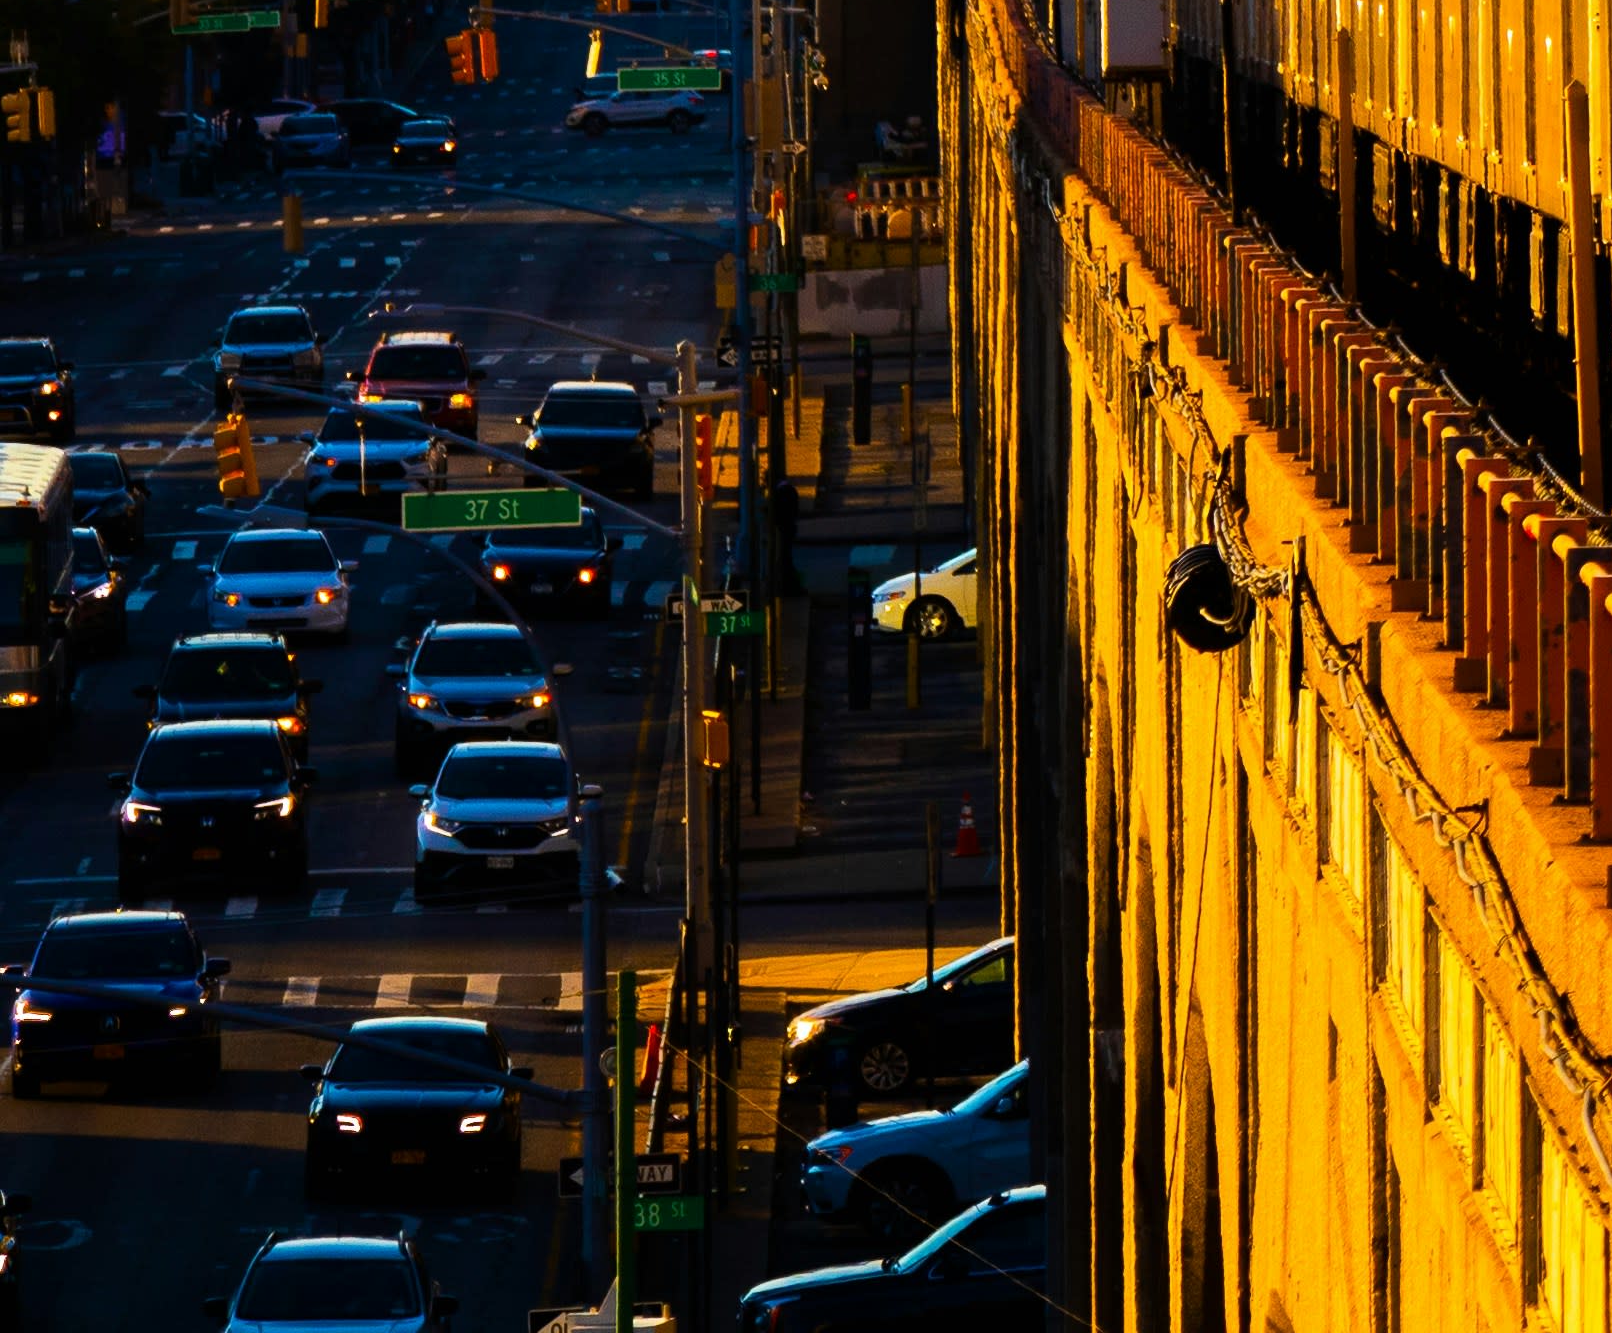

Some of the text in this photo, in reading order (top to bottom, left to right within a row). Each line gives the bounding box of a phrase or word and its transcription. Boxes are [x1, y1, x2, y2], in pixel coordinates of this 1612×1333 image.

[653, 71, 687, 86] 35 St
[464, 498, 521, 522] 37 St
[710, 599, 735, 612] WAY
[720, 616, 737, 634] 37
[634, 1201, 686, 1227] 38 St
